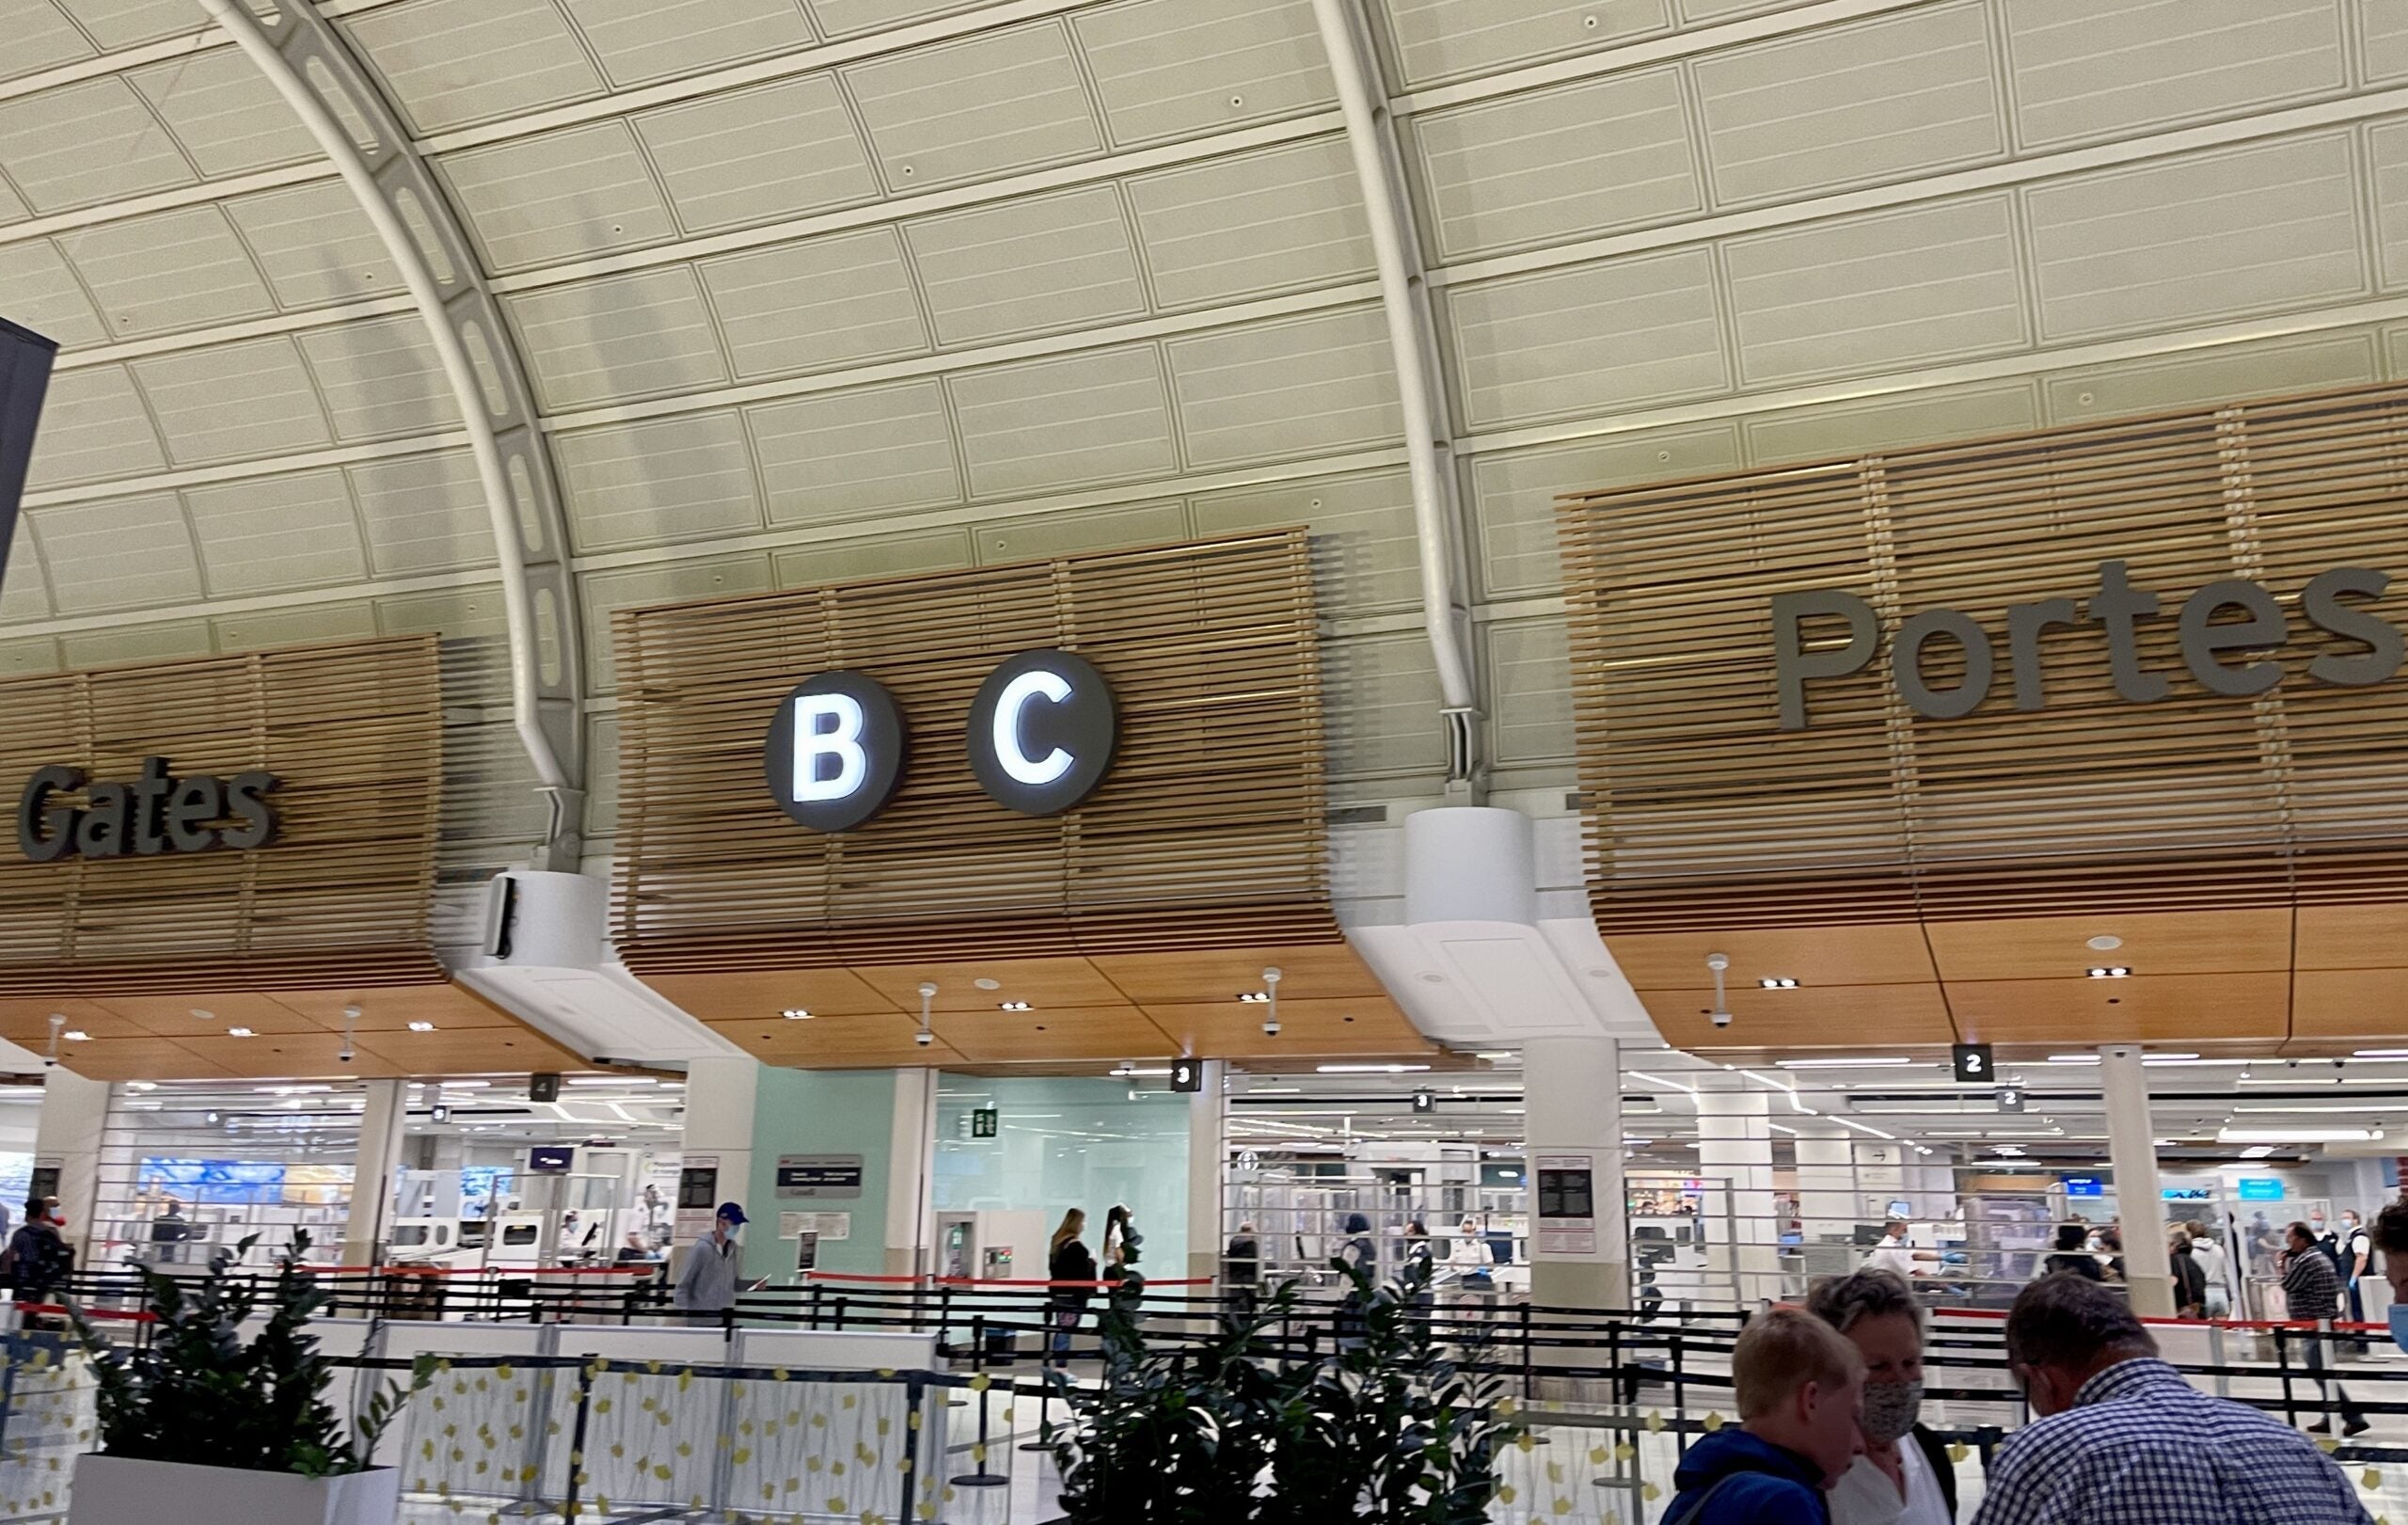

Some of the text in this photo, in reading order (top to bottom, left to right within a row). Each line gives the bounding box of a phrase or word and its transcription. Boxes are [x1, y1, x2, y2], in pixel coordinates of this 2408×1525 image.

[1771, 560, 2405, 732] Portes
[792, 671, 1075, 802] B C
[18, 756, 278, 863] Gates
[1966, 1054, 1982, 1072] 2
[1177, 1067, 1190, 1083] 3
[1418, 1094, 1428, 1107] 3
[2004, 1091, 2017, 1104] 2
